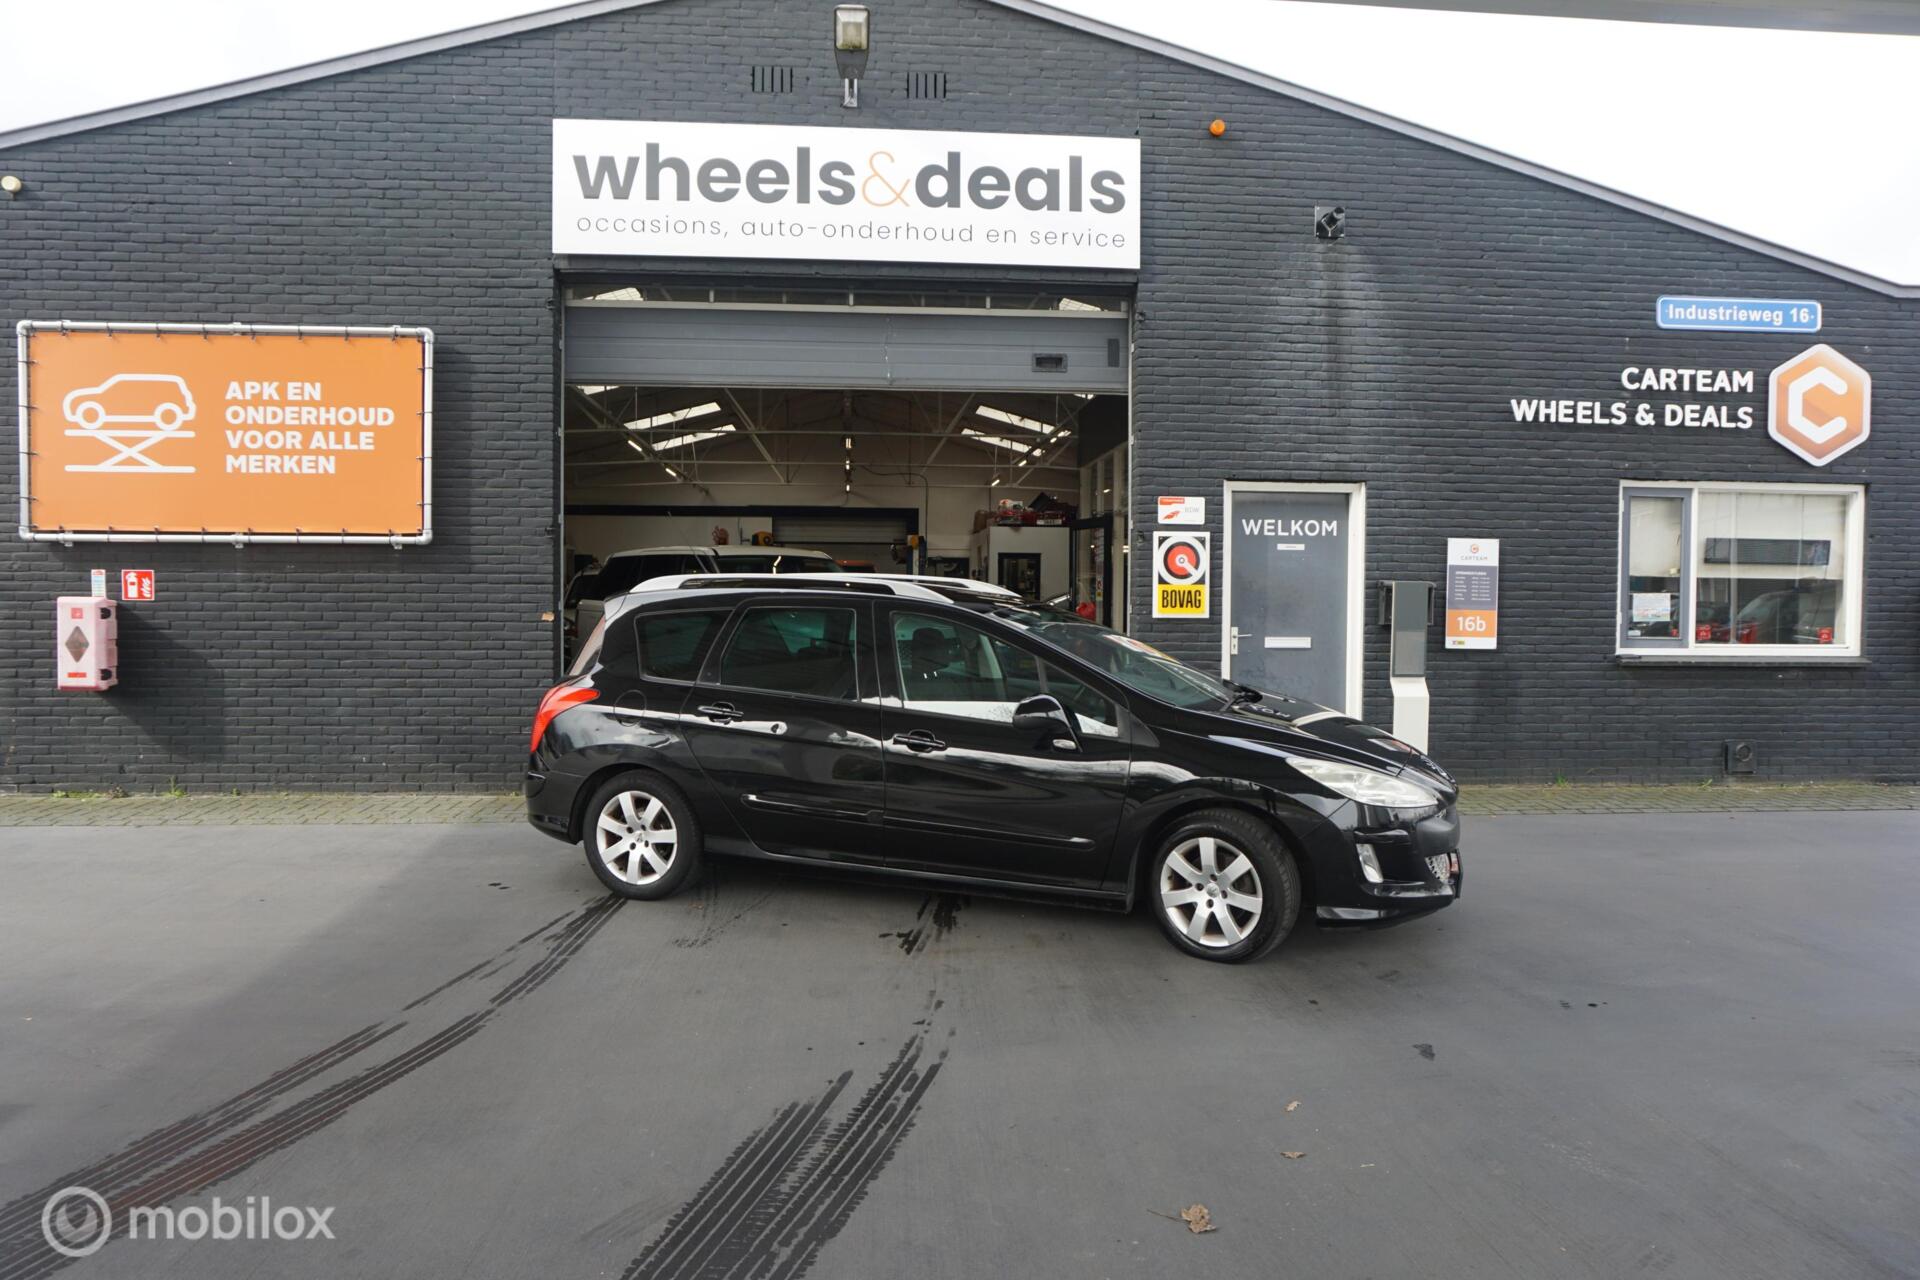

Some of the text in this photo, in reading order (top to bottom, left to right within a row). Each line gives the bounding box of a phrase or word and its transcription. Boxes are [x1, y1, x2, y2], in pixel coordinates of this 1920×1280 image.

[577, 214, 1126, 248] occasions, auto-onderhoud en service
[1668, 304, 1810, 325] Industrieweg 16
[1621, 367, 1754, 393] CARTEAM
[225, 381, 321, 400] APK EN
[225, 405, 395, 426] ONDERHOUD
[1511, 399, 1753, 429] WHEELS & DEALS
[225, 430, 375, 450] VOOR ALLE
[225, 455, 336, 474] MERKEN
[1241, 519, 1338, 537] WELKOM
[1162, 590, 1202, 609] BOVAG
[1457, 616, 1486, 632] 16b
